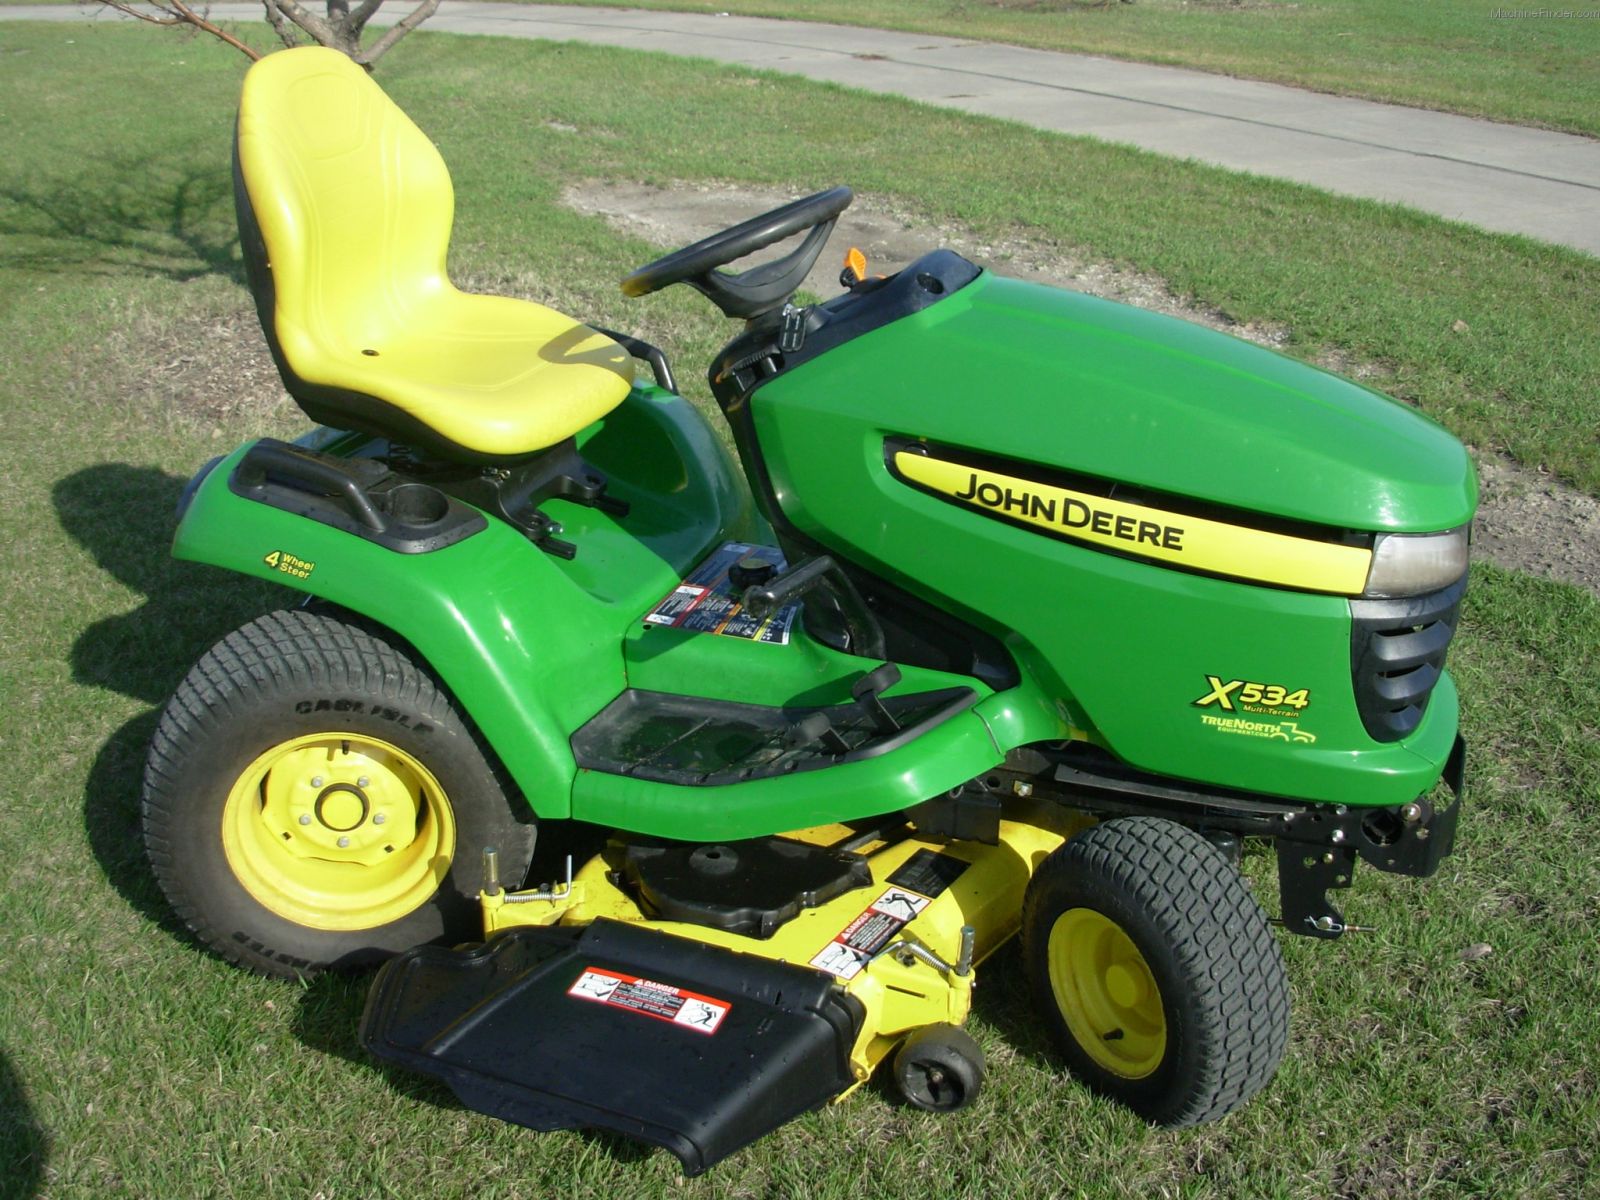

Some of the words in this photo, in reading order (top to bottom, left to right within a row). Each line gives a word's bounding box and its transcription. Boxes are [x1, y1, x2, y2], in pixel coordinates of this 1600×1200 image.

[954, 473, 1056, 522] JOHN
[1061, 497, 1185, 551] DEERE
[264, 550, 281, 567] 4
[283, 553, 315, 572] Wheel
[280, 562, 310, 579] Steer
[1193, 675, 1310, 712] X534
[1243, 704, 1300, 718] Multi-Terrain
[847, 911, 873, 936] DANGER
[644, 980, 681, 995] DANGER
